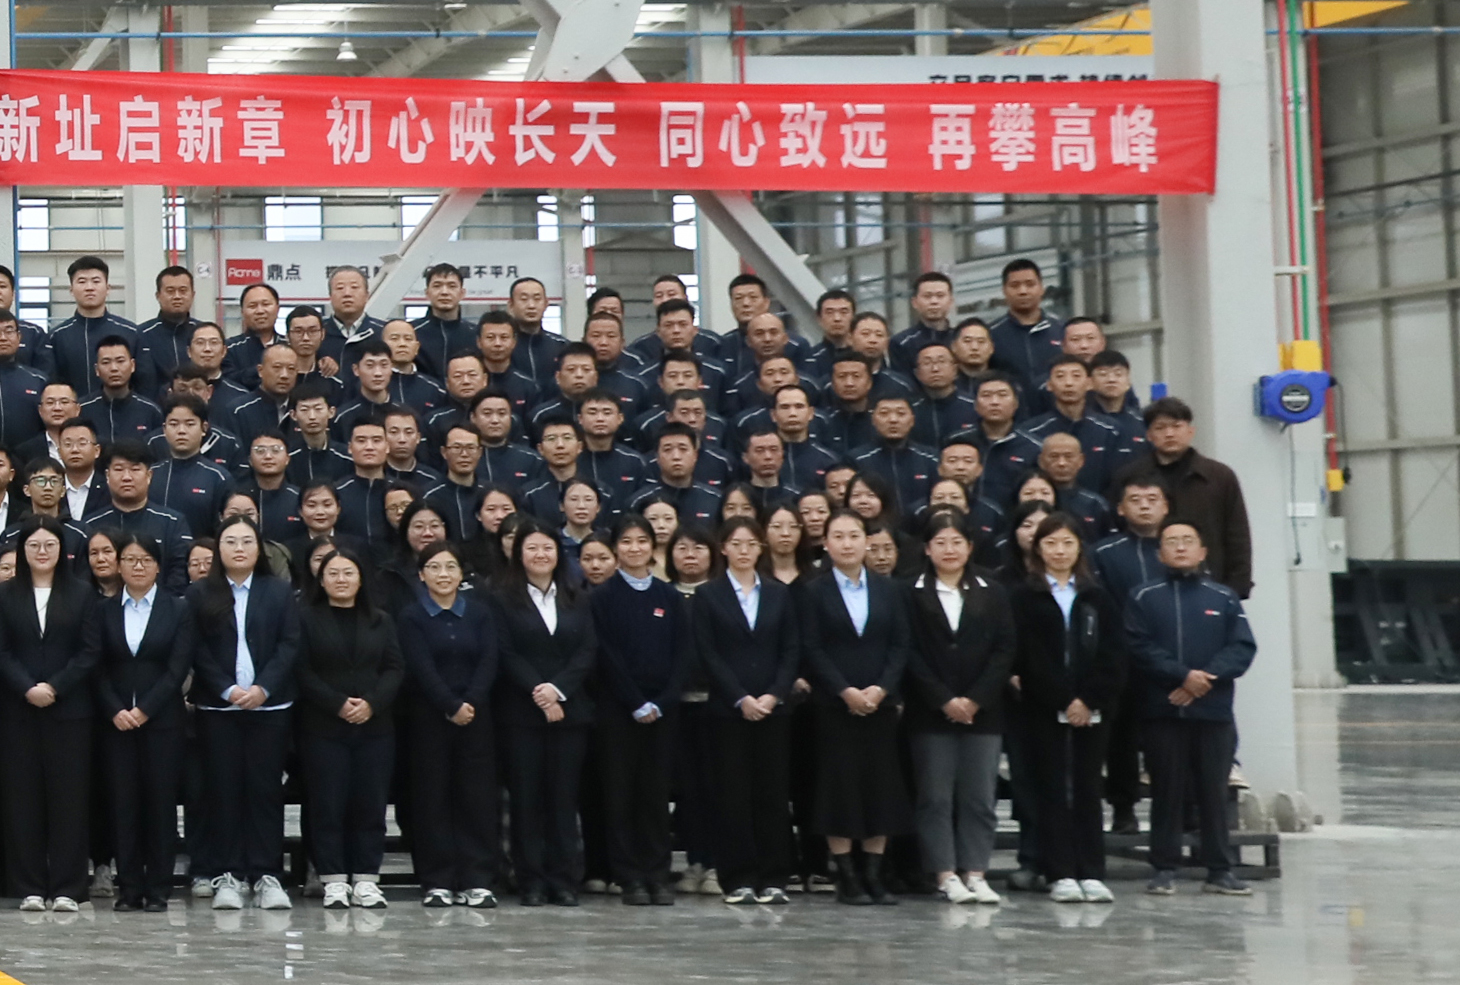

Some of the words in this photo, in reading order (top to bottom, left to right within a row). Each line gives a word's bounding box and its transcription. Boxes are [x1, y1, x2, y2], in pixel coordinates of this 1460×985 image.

[326, 95, 617, 168] 初心映长天
[659, 101, 888, 170] 同心致远
[928, 102, 1159, 174] 再攀高峰
[227, 266, 261, 278] Acme
[267, 263, 302, 281] 鼎点
